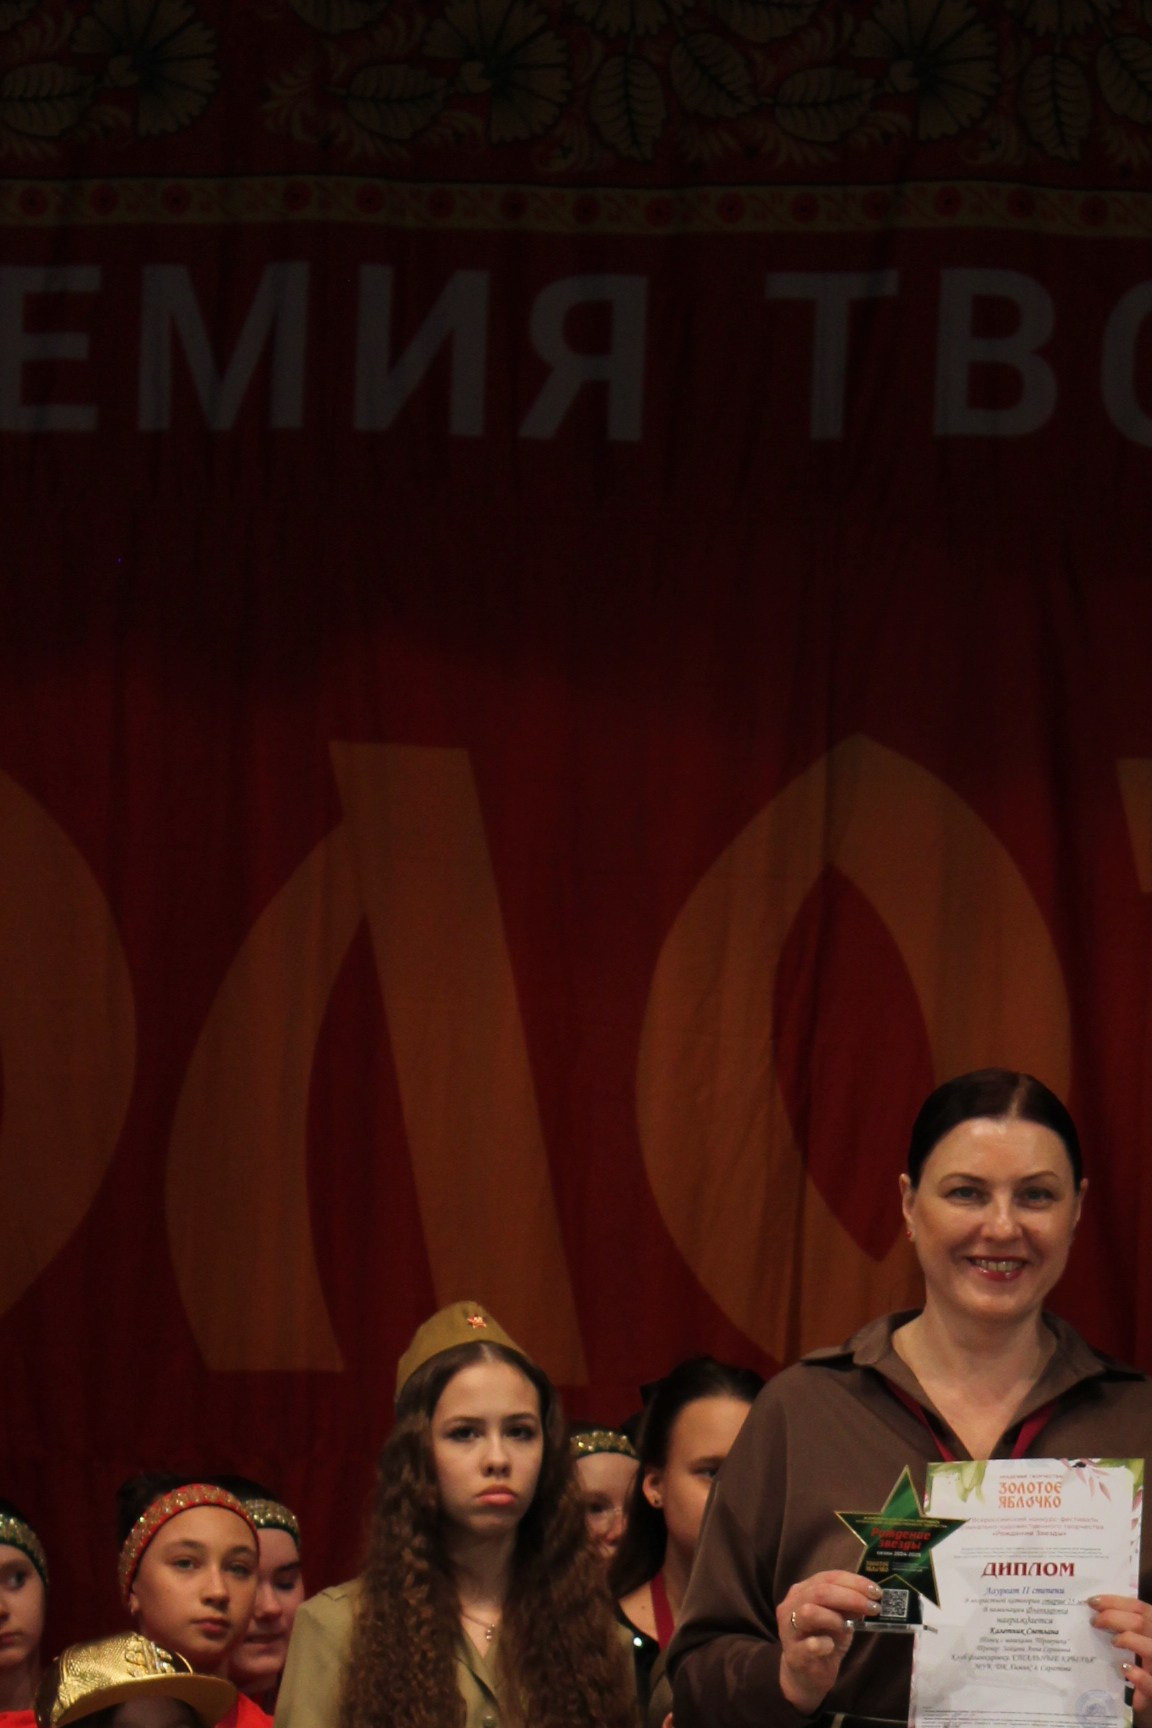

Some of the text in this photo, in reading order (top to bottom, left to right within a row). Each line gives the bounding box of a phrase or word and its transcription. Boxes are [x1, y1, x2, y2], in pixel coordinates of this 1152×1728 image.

[0, 261, 650, 442] ЕМИЯ
[998, 1481, 1062, 1495] ЗОЛОТОЕ
[998, 1495, 1062, 1509] ЯБЛОЧКО
[871, 1527, 932, 1542] Рождение
[879, 1540, 922, 1551] звезды
[981, 1562, 1075, 1578] ДИПЛОМ
[985, 1586, 1019, 1596] Лауреат
[1022, 1586, 1030, 1594] II
[997, 1616, 1053, 1625] награждается
